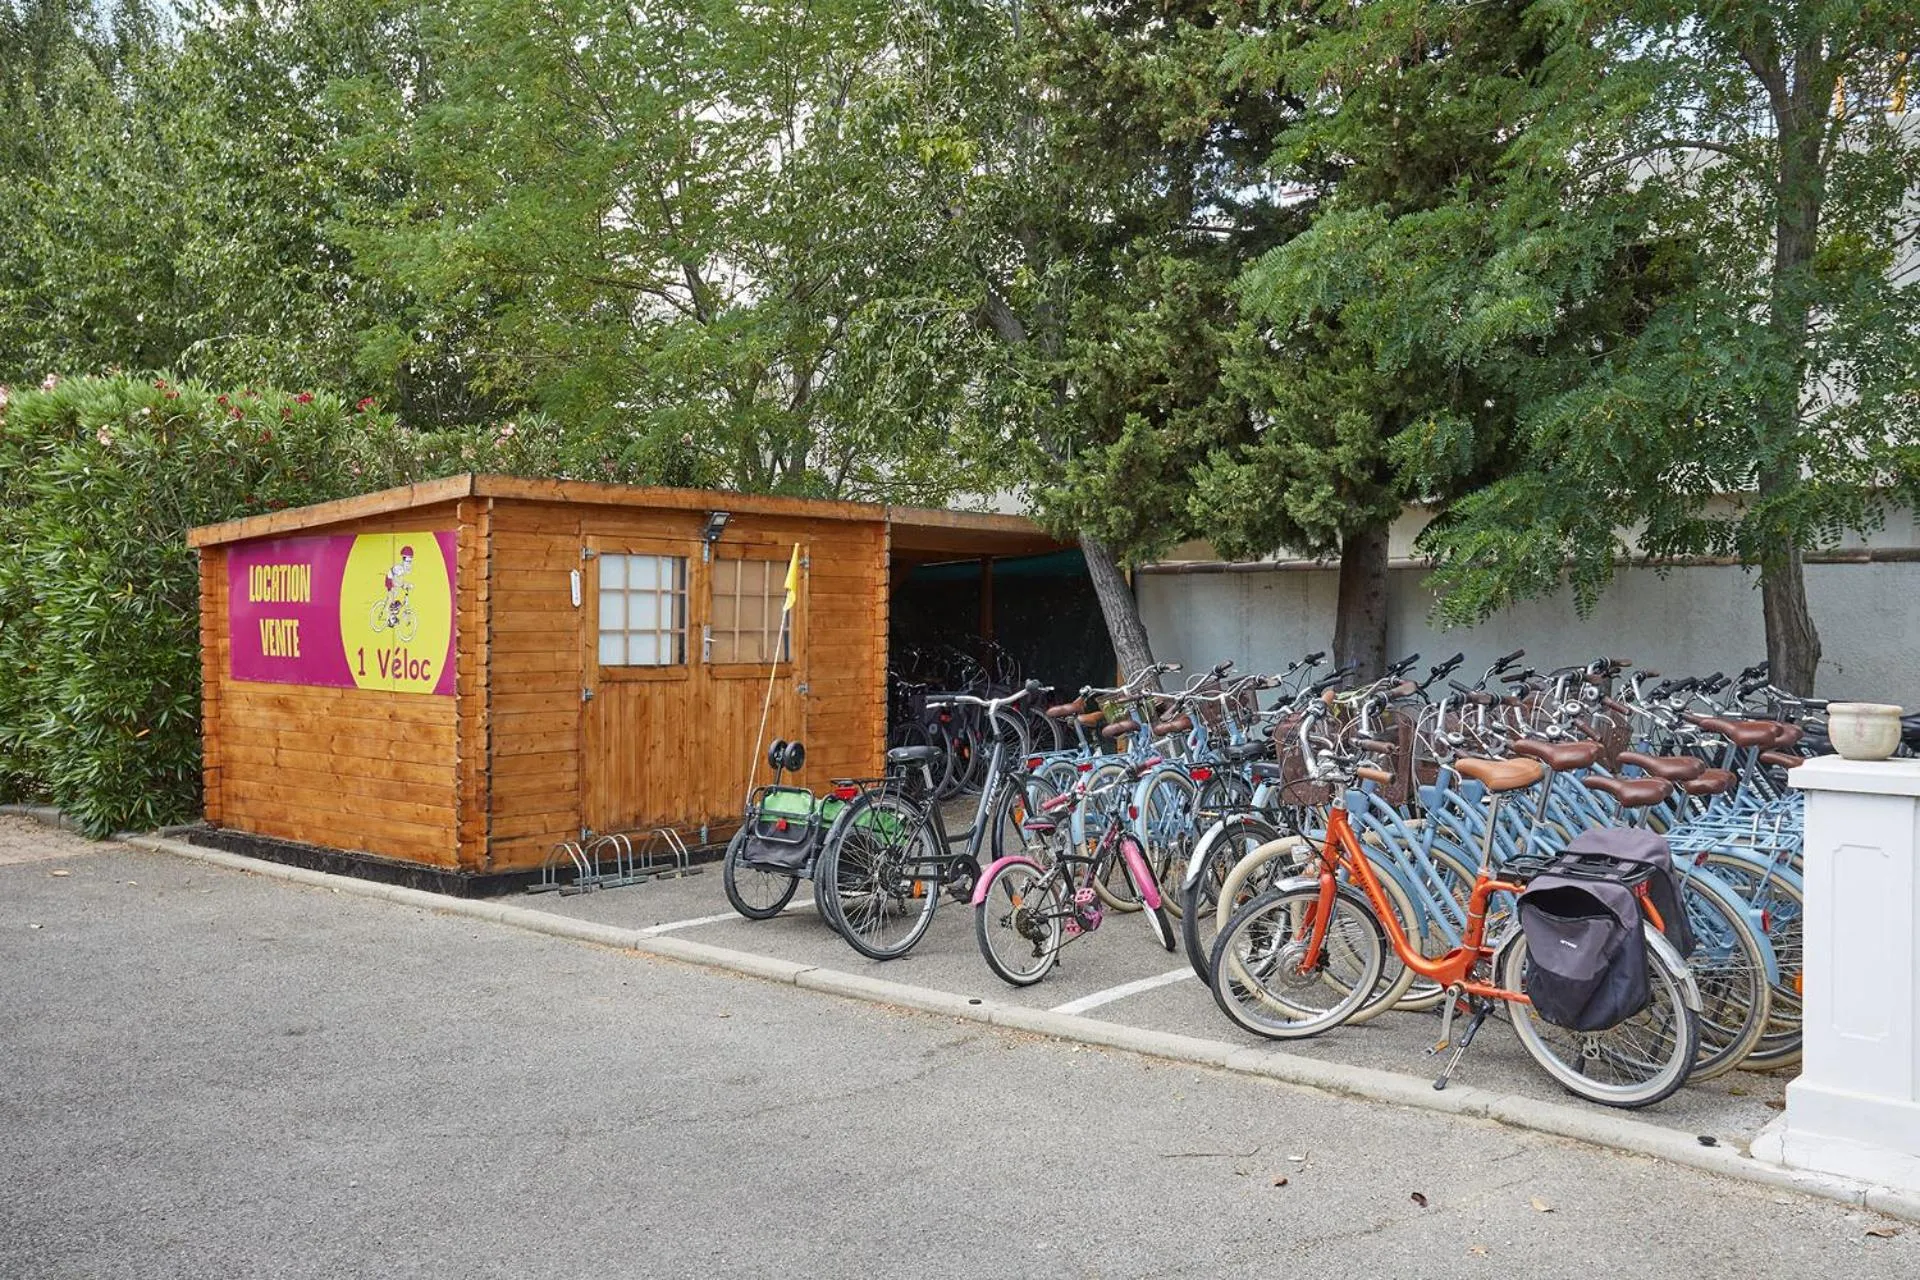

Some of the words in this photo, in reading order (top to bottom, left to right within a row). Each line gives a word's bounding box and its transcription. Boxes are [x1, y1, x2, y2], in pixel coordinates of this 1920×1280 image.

[249, 564, 311, 603] LOCATION
[259, 618, 300, 658] VENTE
[358, 647, 366, 676] 1
[377, 647, 431, 681] Véloc
